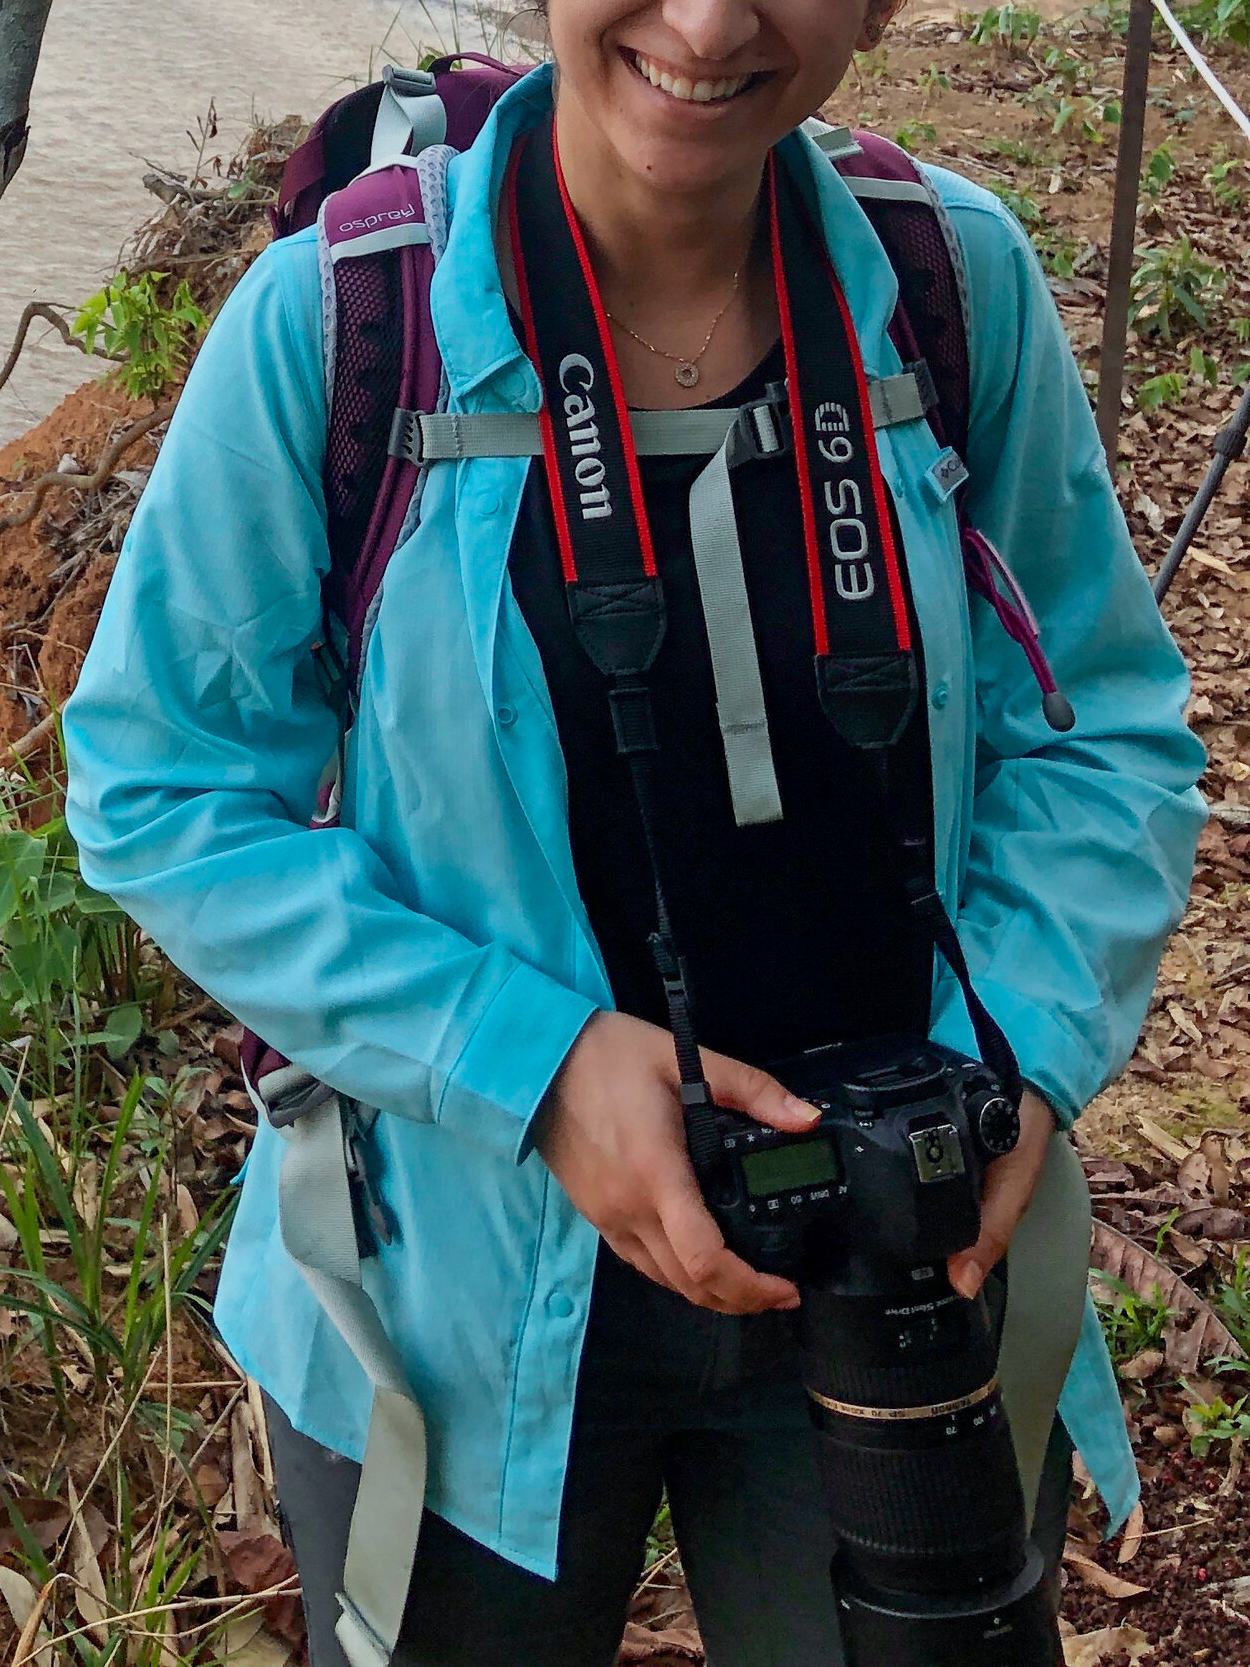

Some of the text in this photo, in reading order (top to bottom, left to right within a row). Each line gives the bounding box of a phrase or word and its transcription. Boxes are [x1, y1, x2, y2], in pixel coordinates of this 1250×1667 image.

[339, 202, 416, 233] osprey
[558, 352, 613, 521] Canon
[814, 400, 876, 602] EOS 6D
